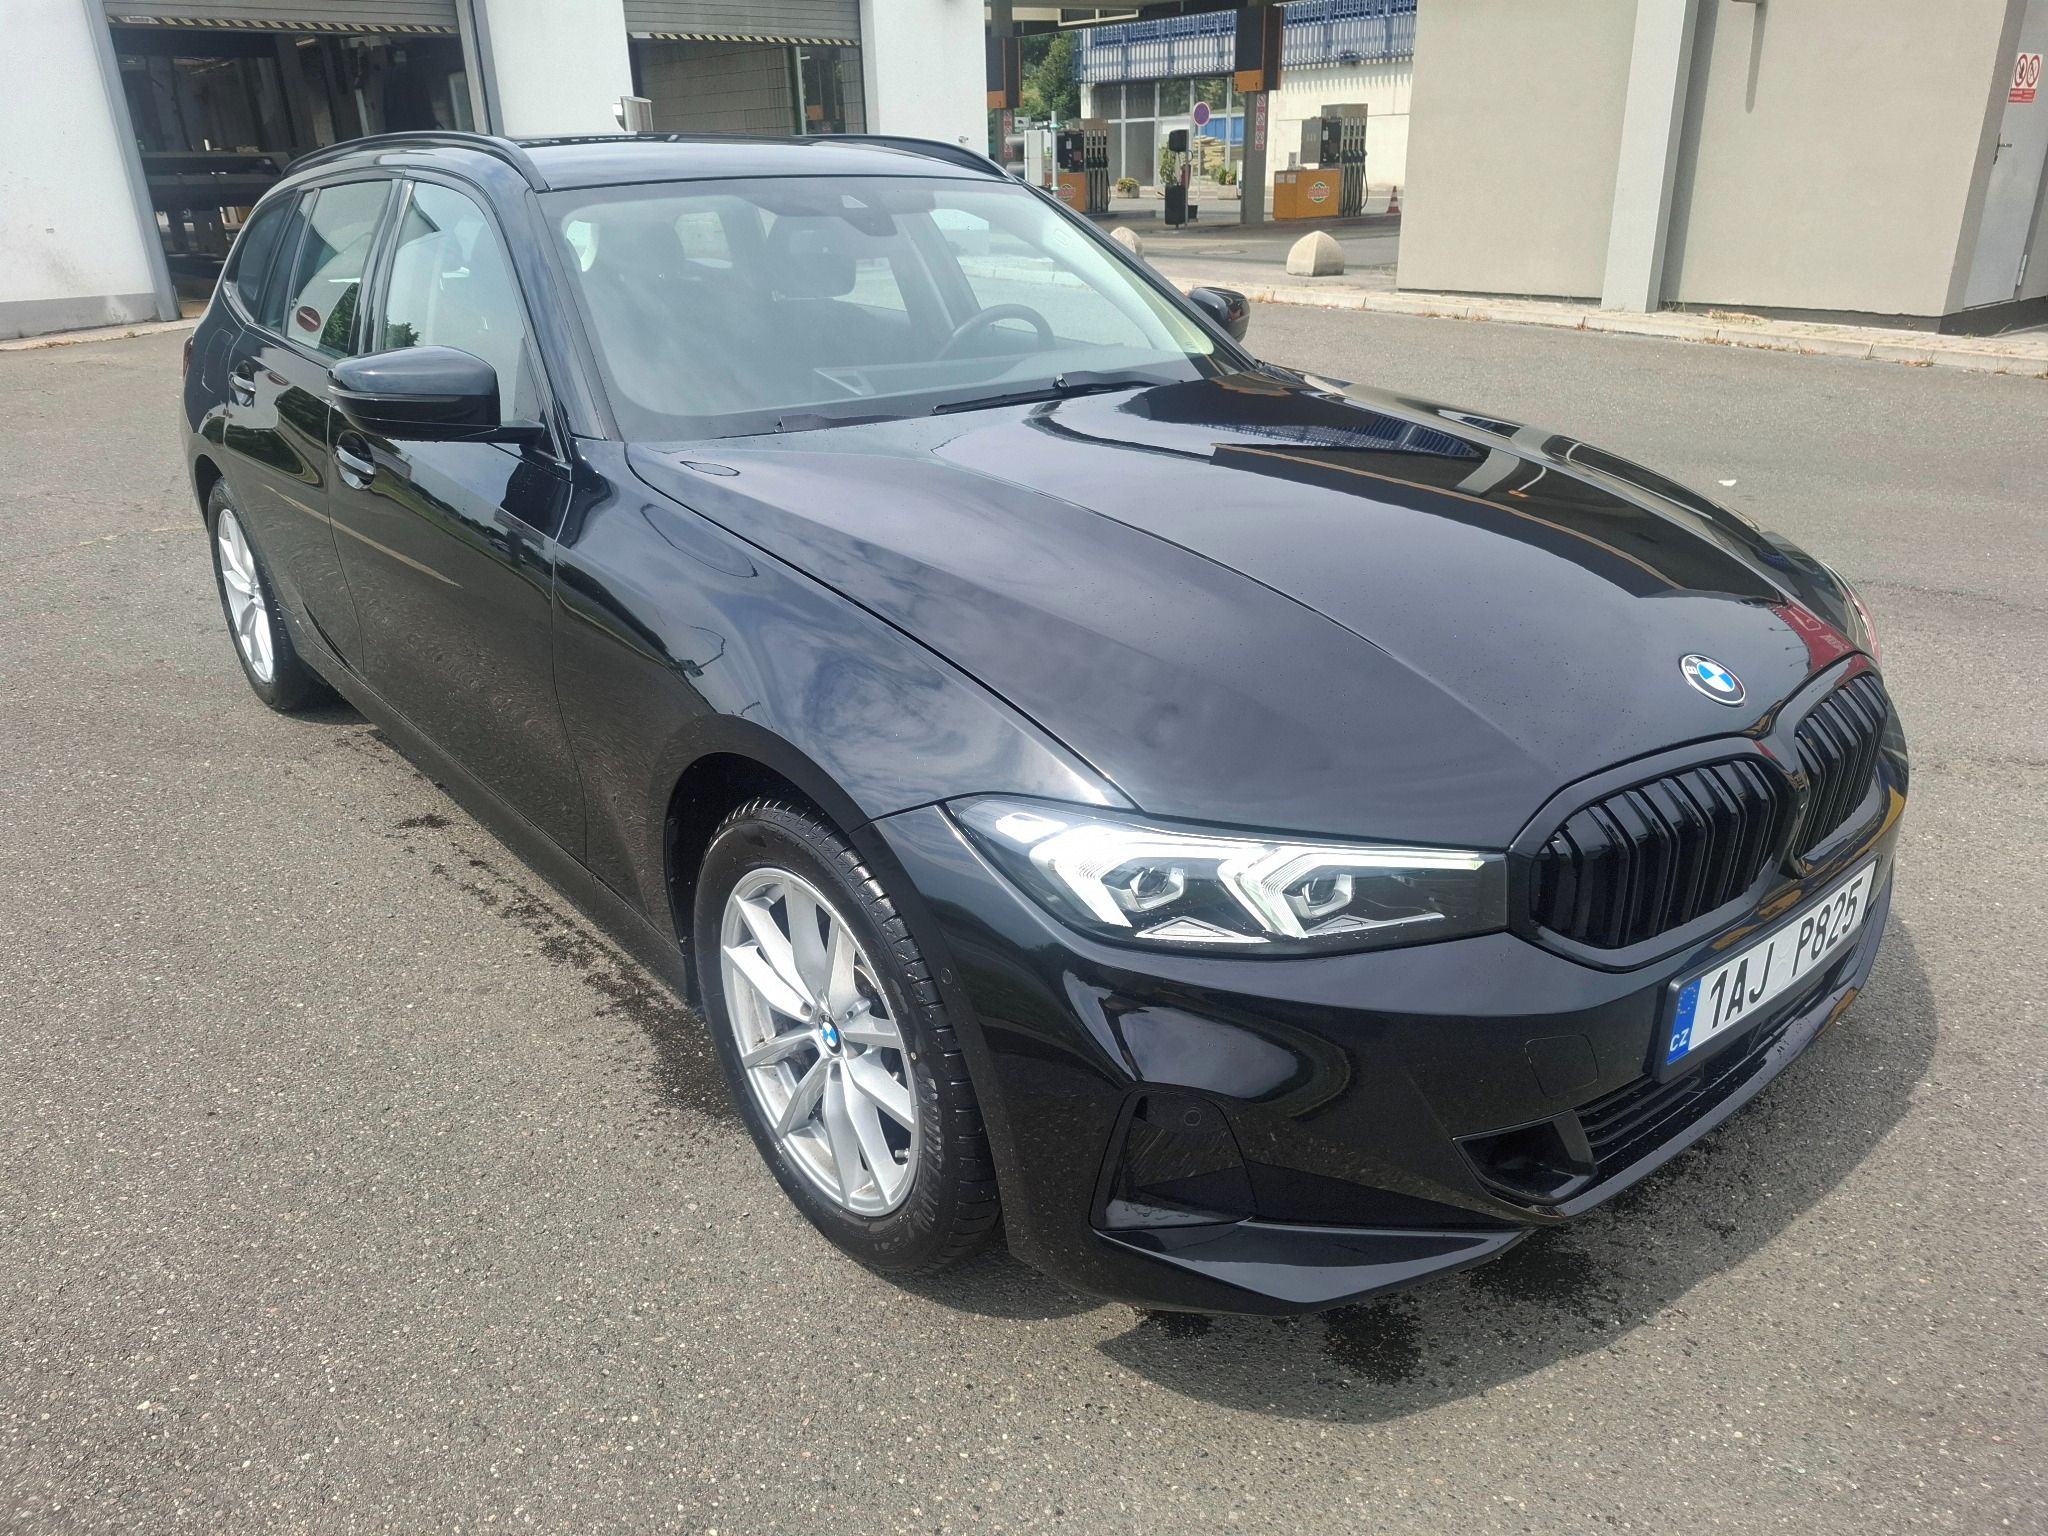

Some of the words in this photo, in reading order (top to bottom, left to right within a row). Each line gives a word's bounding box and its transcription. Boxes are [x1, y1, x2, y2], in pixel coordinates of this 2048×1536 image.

[1709, 942, 1774, 1029] 1AJ
[1791, 876, 1863, 978] P825
[1670, 1028, 1688, 1052] CZ
